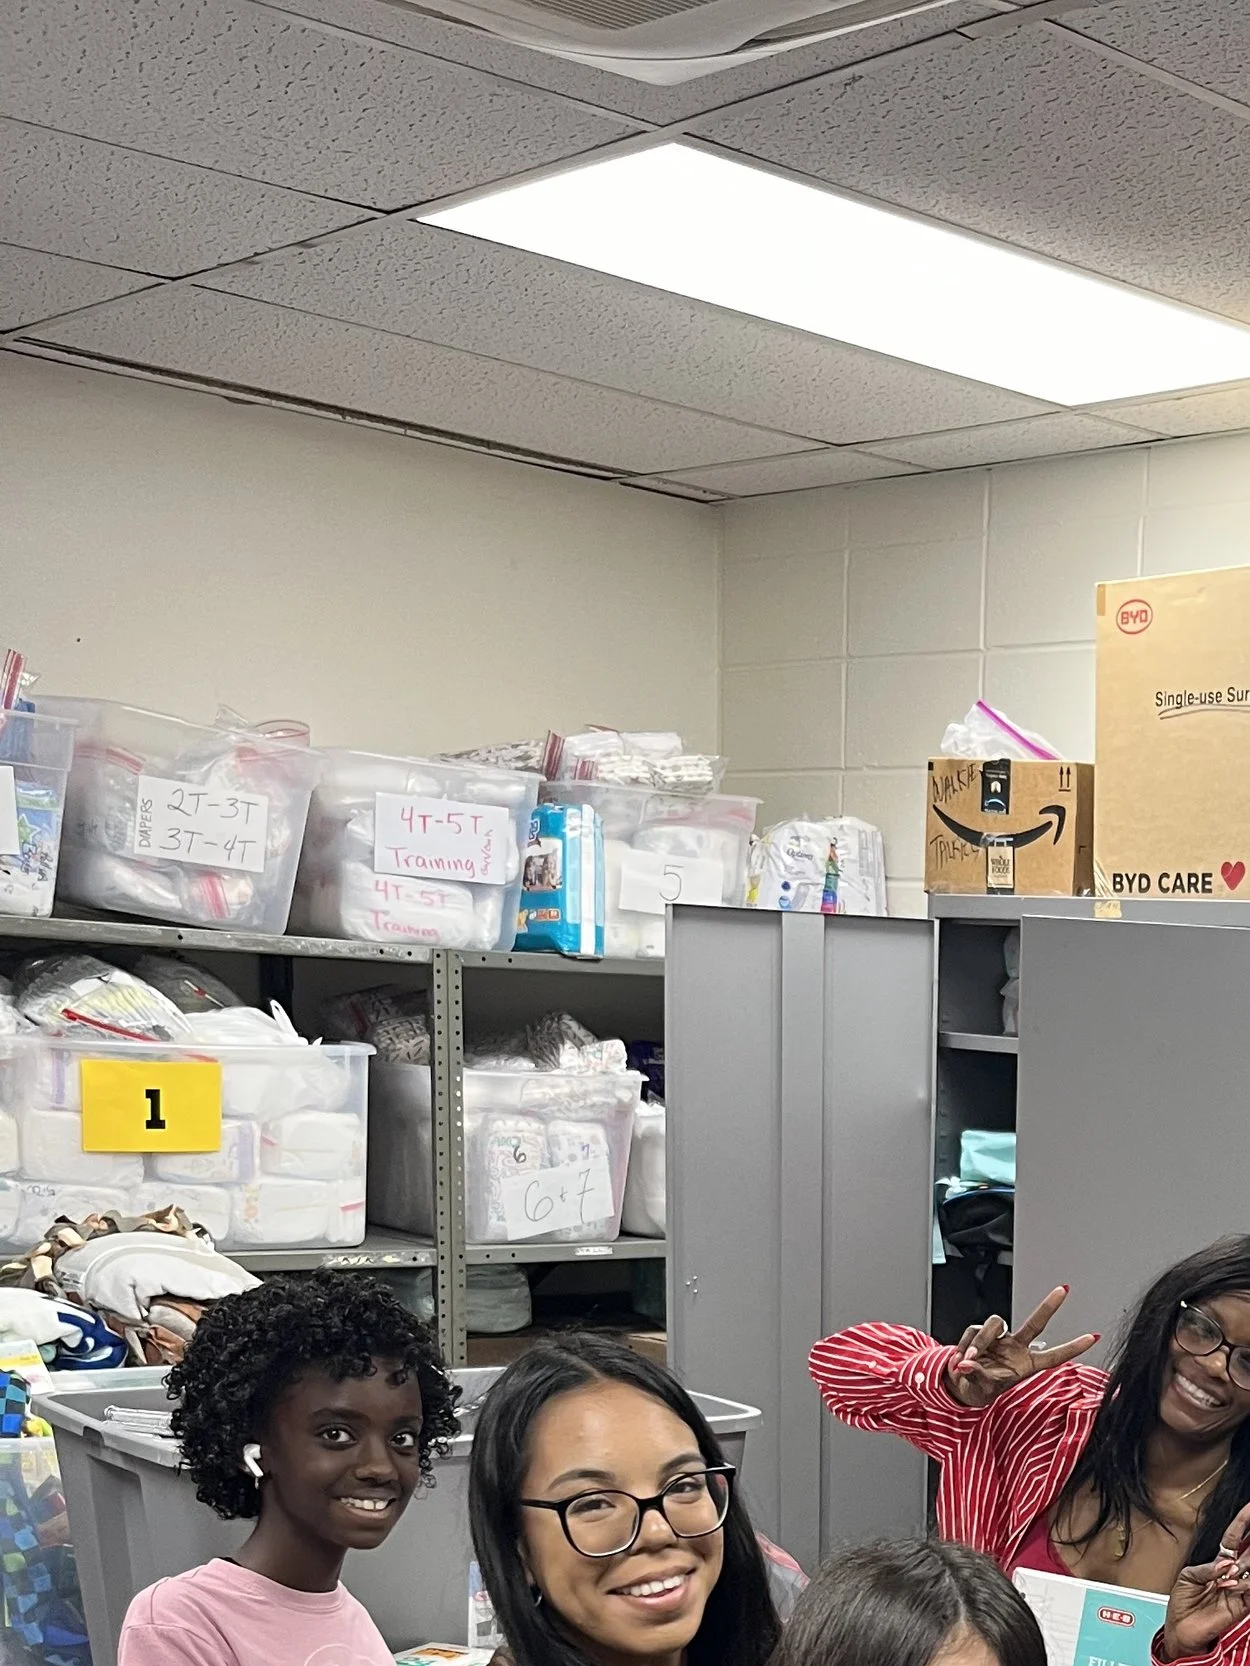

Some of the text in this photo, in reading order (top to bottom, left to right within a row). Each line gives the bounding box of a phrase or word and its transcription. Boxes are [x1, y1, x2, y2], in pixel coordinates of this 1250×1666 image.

[1121, 609, 1148, 625] BYD
[1155, 690, 1222, 709] Single-use
[139, 798, 152, 848] DIAPERS
[167, 789, 258, 824] 2T-3T
[160, 828, 256, 863] 3T-4T
[386, 846, 475, 878] Training
[660, 865, 684, 901] 5
[1113, 873, 1212, 893] BYD CARE
[369, 909, 441, 941] Training
[145, 1089, 166, 1129] 1
[513, 1145, 526, 1164] 6
[525, 1180, 554, 1222] 6
[577, 1168, 595, 1224] 7
